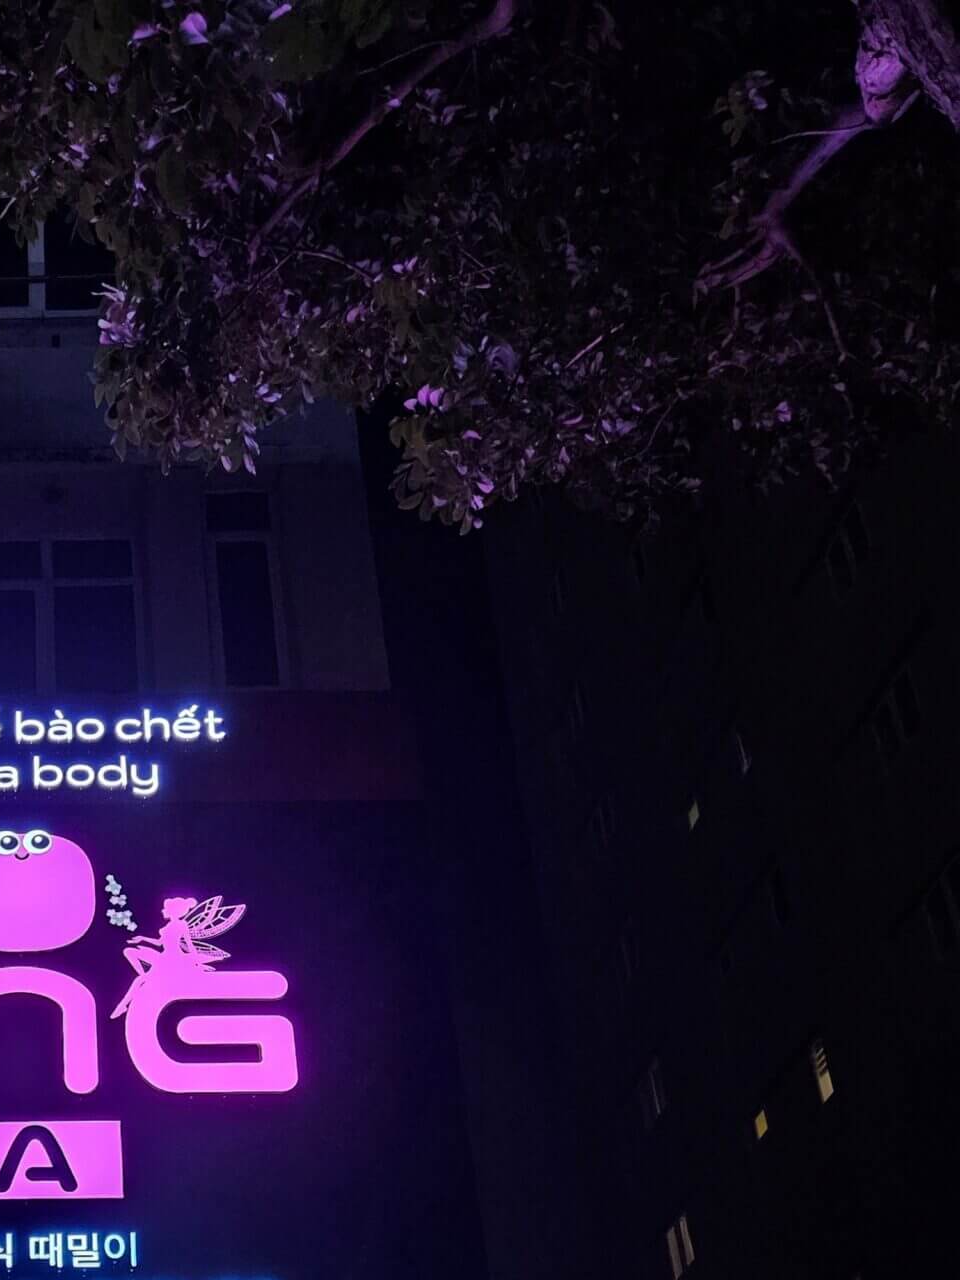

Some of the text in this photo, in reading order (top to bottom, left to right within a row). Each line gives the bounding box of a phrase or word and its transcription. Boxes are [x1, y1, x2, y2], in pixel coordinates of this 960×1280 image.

[15, 709, 105, 744] bào
[114, 704, 226, 743] chết
[33, 755, 159, 799] body
[28, 1232, 138, 1268] 때밀이
